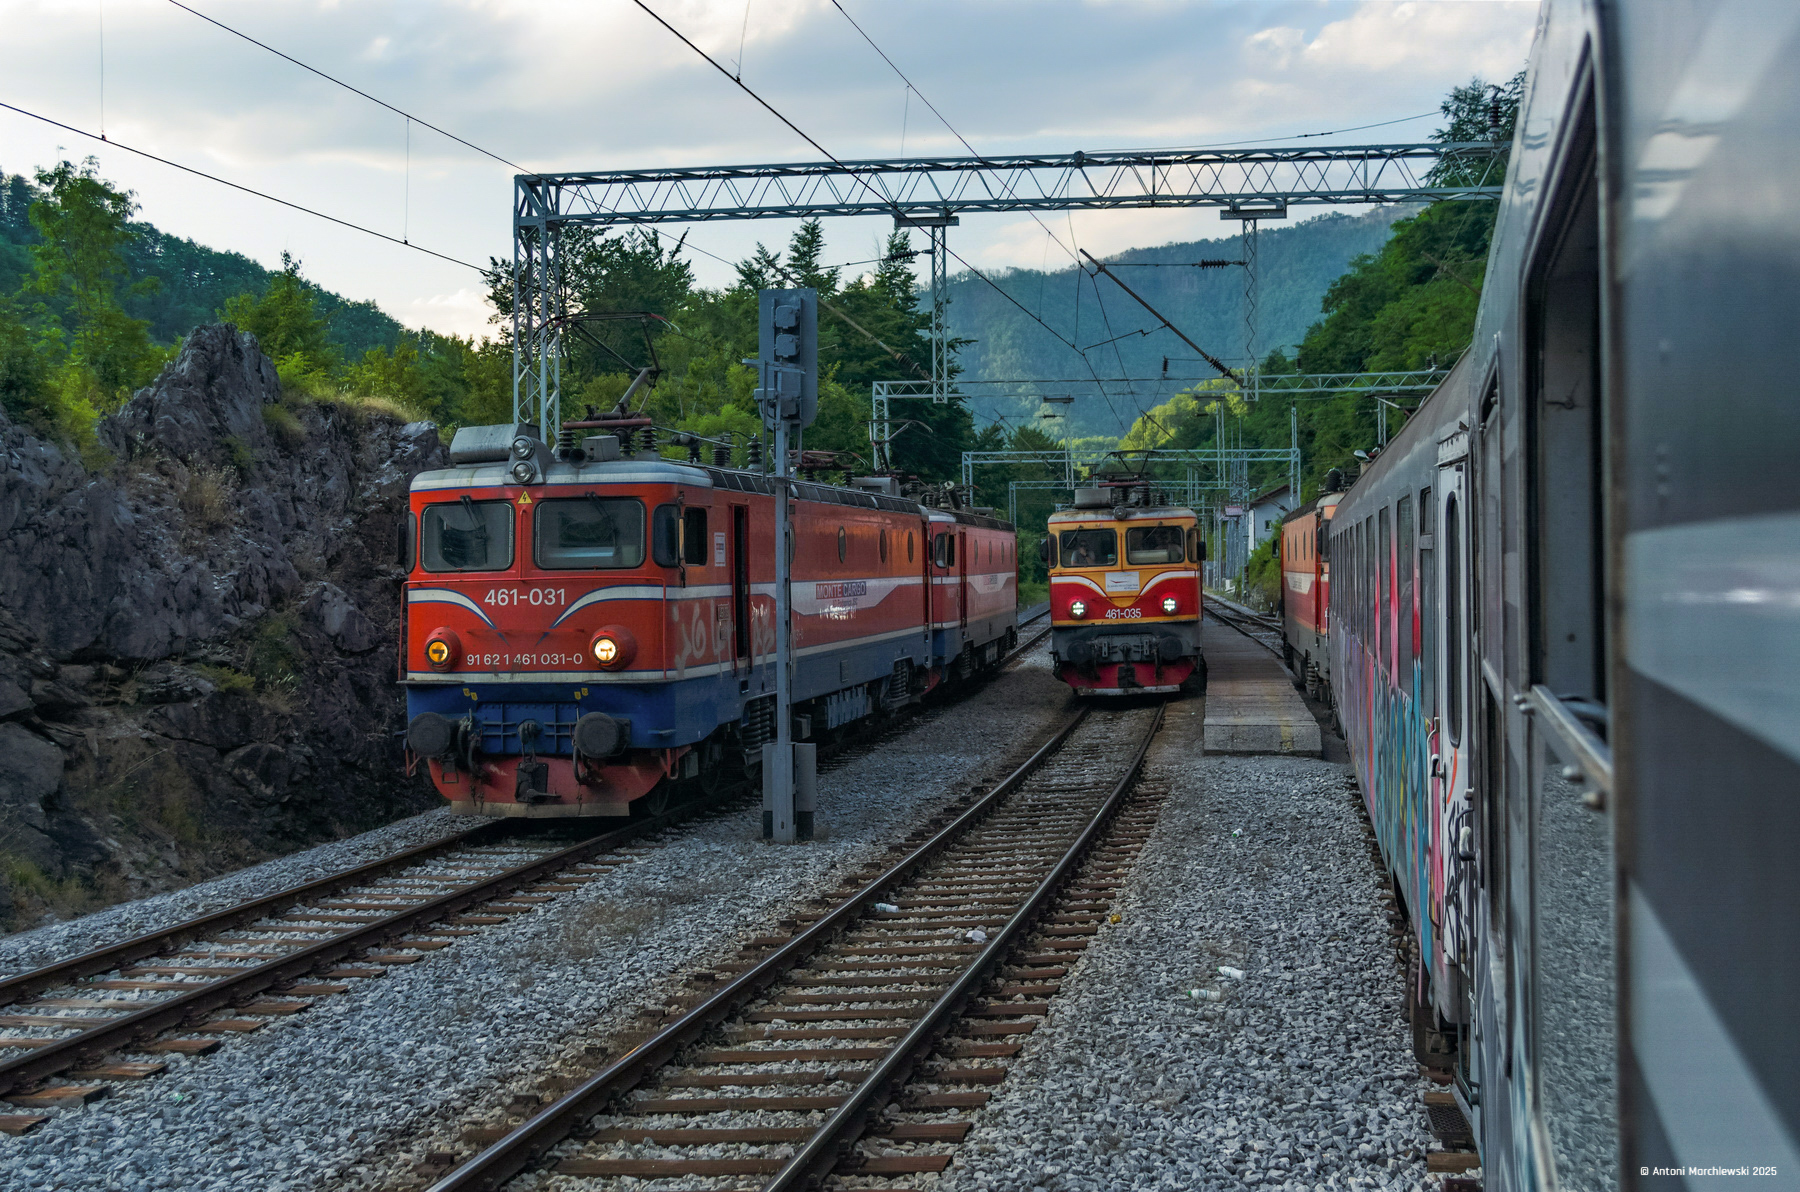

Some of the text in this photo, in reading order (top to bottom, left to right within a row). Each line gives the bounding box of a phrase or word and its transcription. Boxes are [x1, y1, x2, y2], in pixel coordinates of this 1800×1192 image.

[484, 588, 565, 606] 461-031
[816, 582, 866, 598] MONTE CARGO
[1105, 608, 1142, 619] 461-035
[466, 653, 583, 666] 91 62 1 461 031-0
